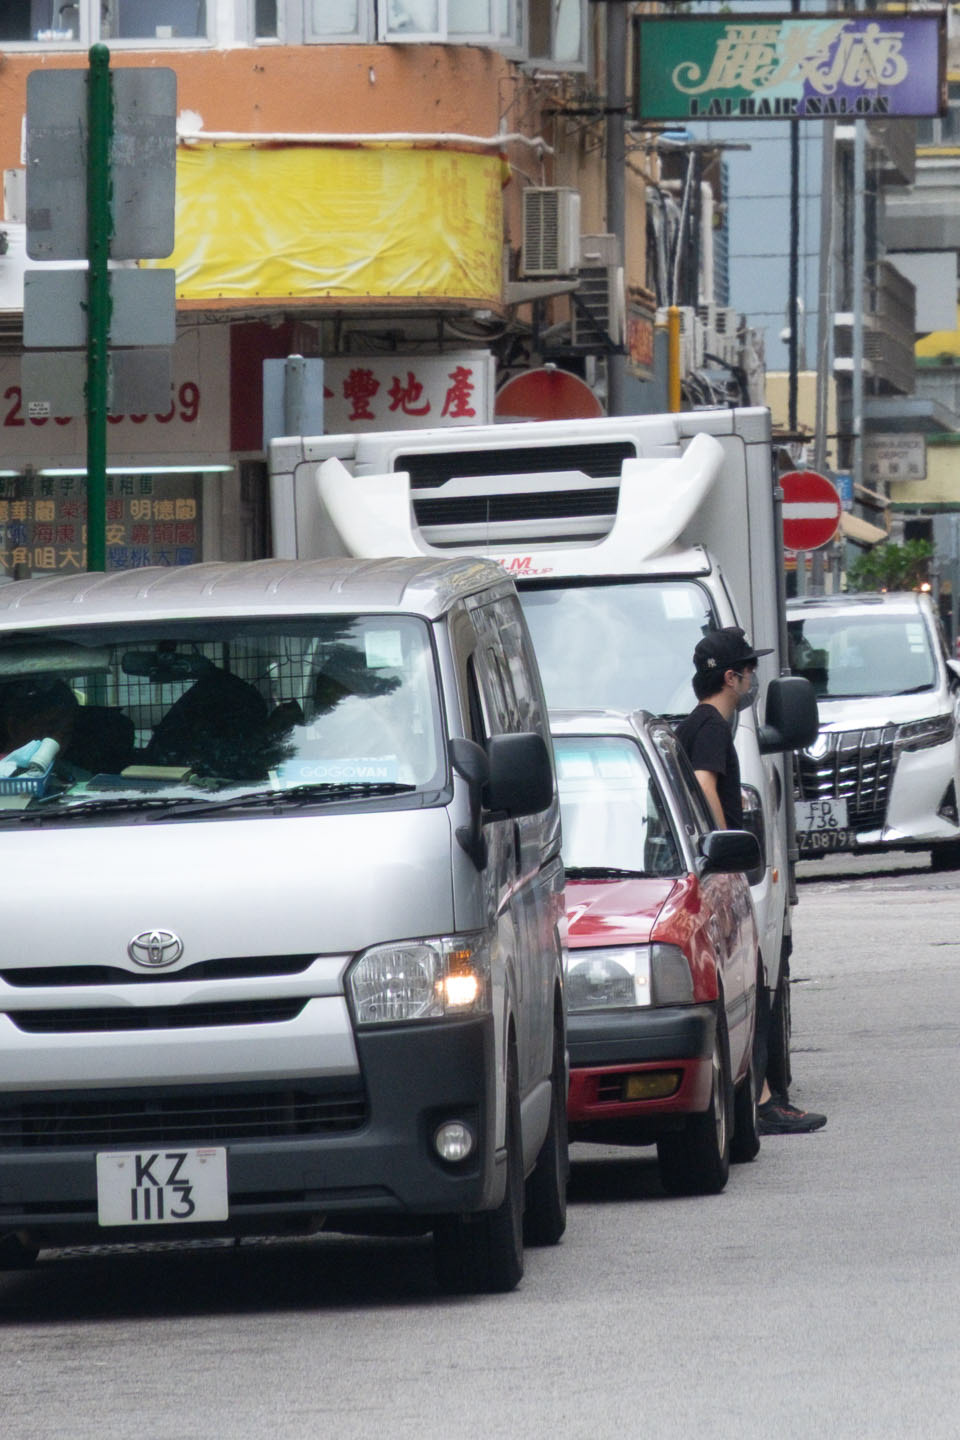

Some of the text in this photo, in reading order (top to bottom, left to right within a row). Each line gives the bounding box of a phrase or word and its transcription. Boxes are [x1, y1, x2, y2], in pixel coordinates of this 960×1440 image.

[738, 96, 799, 116] HAIR
[324, 366, 476, 421] 豐地產
[82, 522, 125, 545] 安
[300, 766, 388, 778] GOGOVAN
[810, 801, 832, 816] FD
[805, 814, 839, 830] 736
[135, 1152, 190, 1187] KZ
[131, 1185, 196, 1221] 1113
